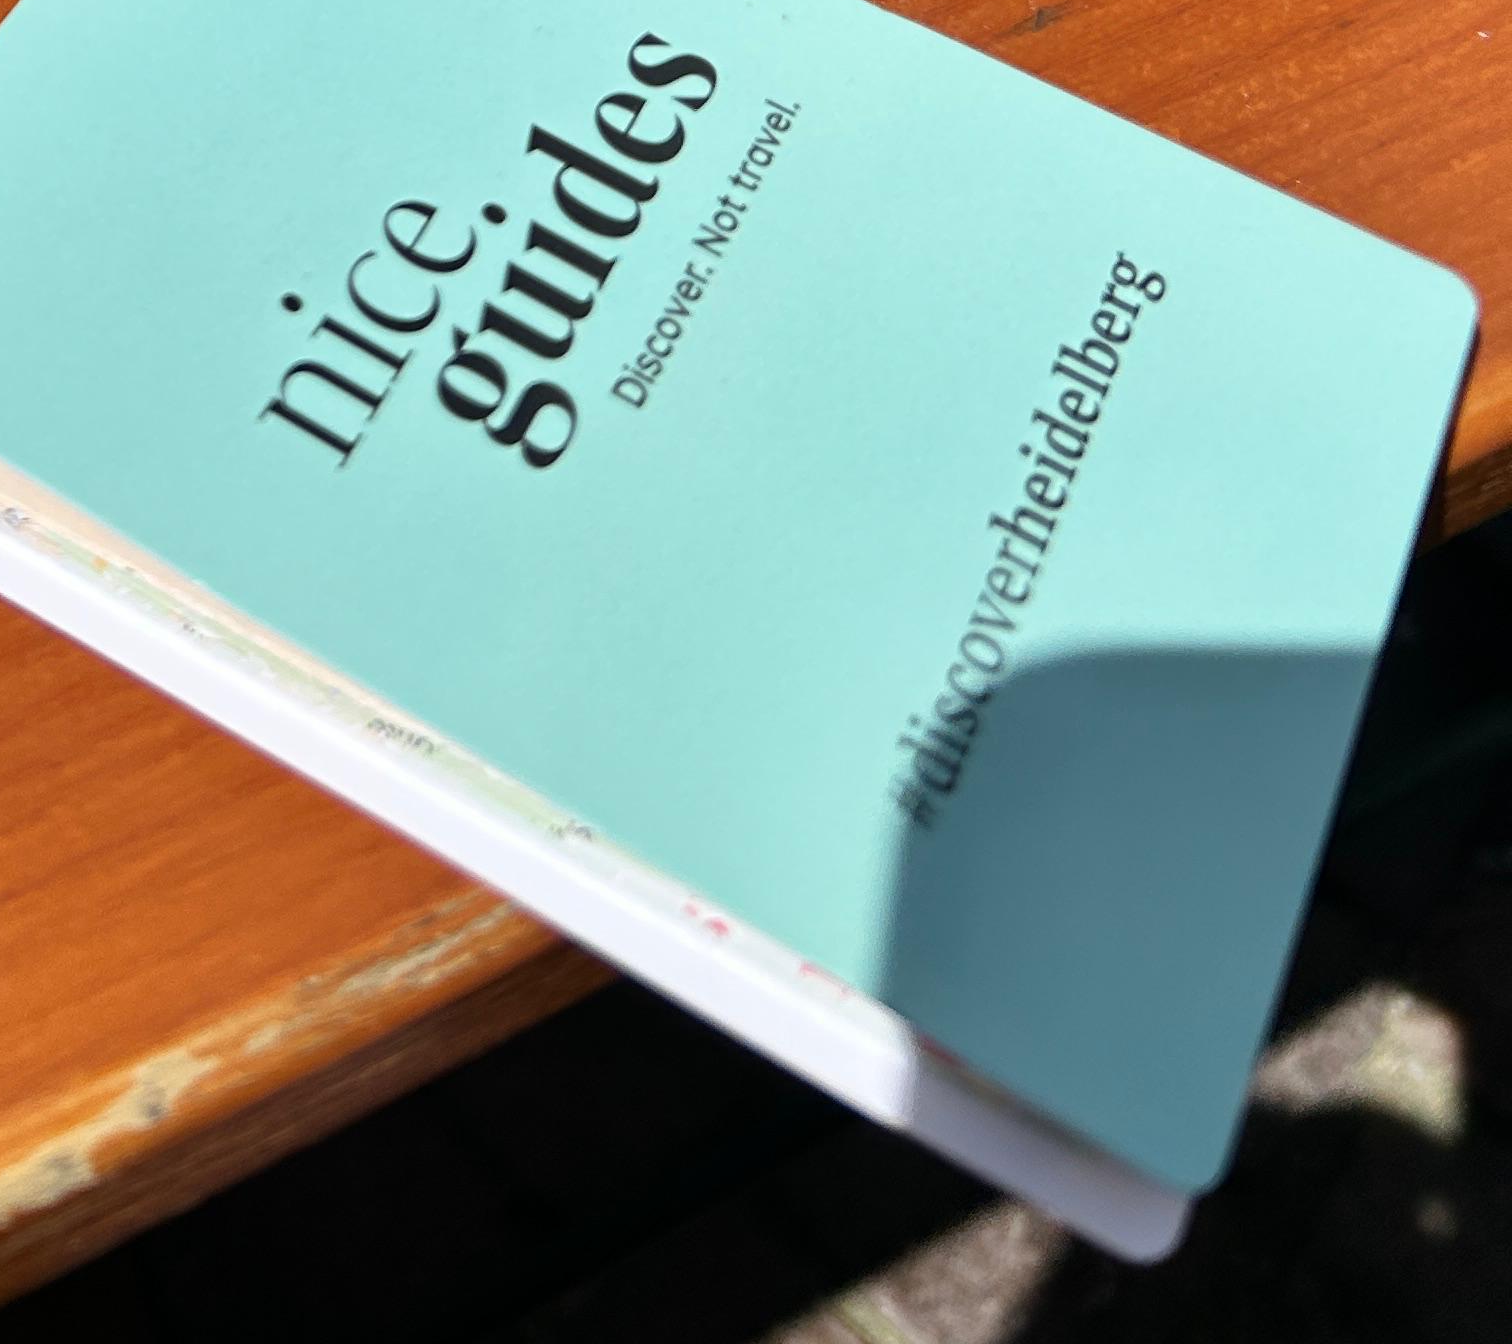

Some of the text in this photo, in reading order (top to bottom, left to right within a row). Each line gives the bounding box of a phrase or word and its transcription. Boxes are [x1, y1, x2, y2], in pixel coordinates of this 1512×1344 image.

[258, 197, 509, 471] nice.
[436, 30, 718, 470] guides
[610, 97, 803, 410] Discover. Not travel.
[888, 249, 1170, 830] #discoverheidelberg
